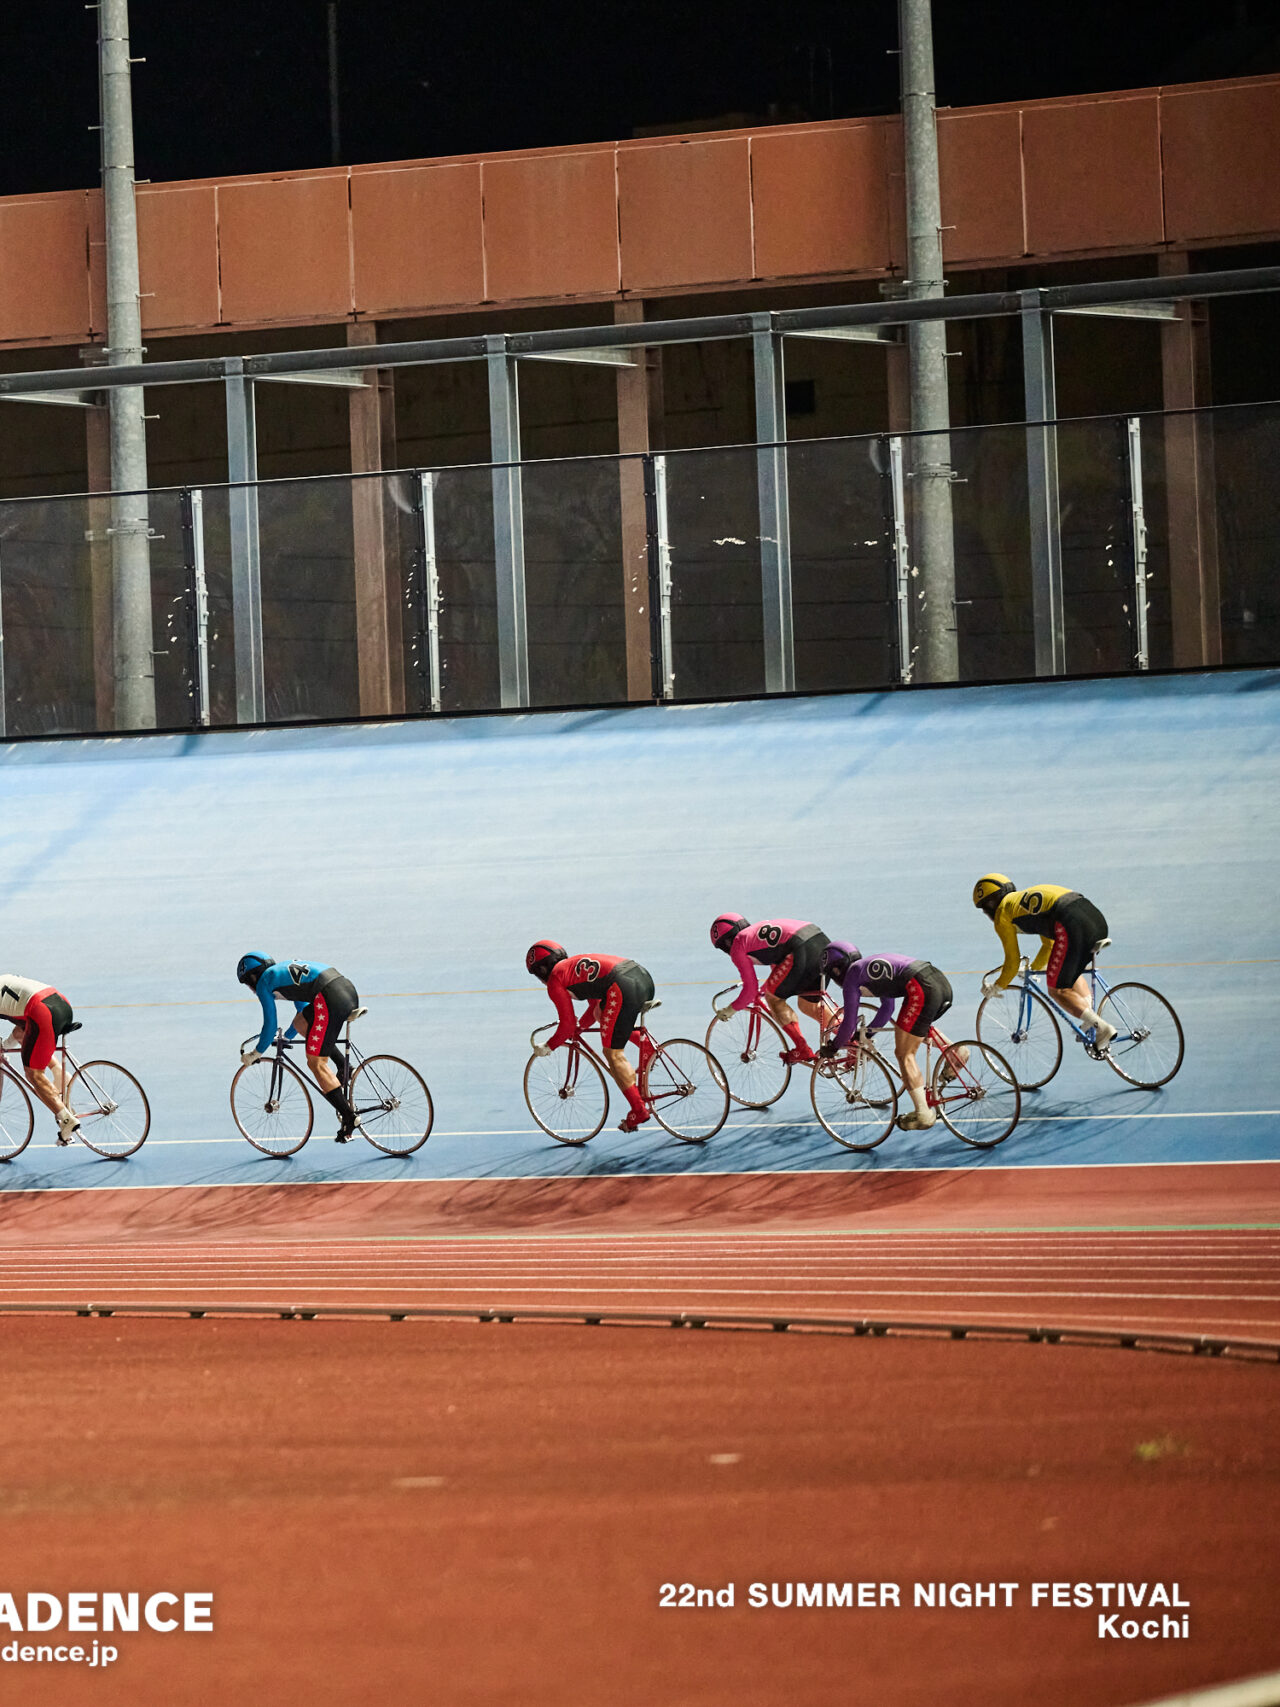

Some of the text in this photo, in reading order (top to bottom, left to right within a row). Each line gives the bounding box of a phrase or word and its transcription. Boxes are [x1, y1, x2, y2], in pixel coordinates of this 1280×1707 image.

[1019, 891, 1043, 915] 5
[757, 924, 782, 948] 8
[529, 948, 536, 964] 3
[288, 963, 310, 986] 4
[575, 957, 601, 982] 3
[867, 958, 893, 980] 9
